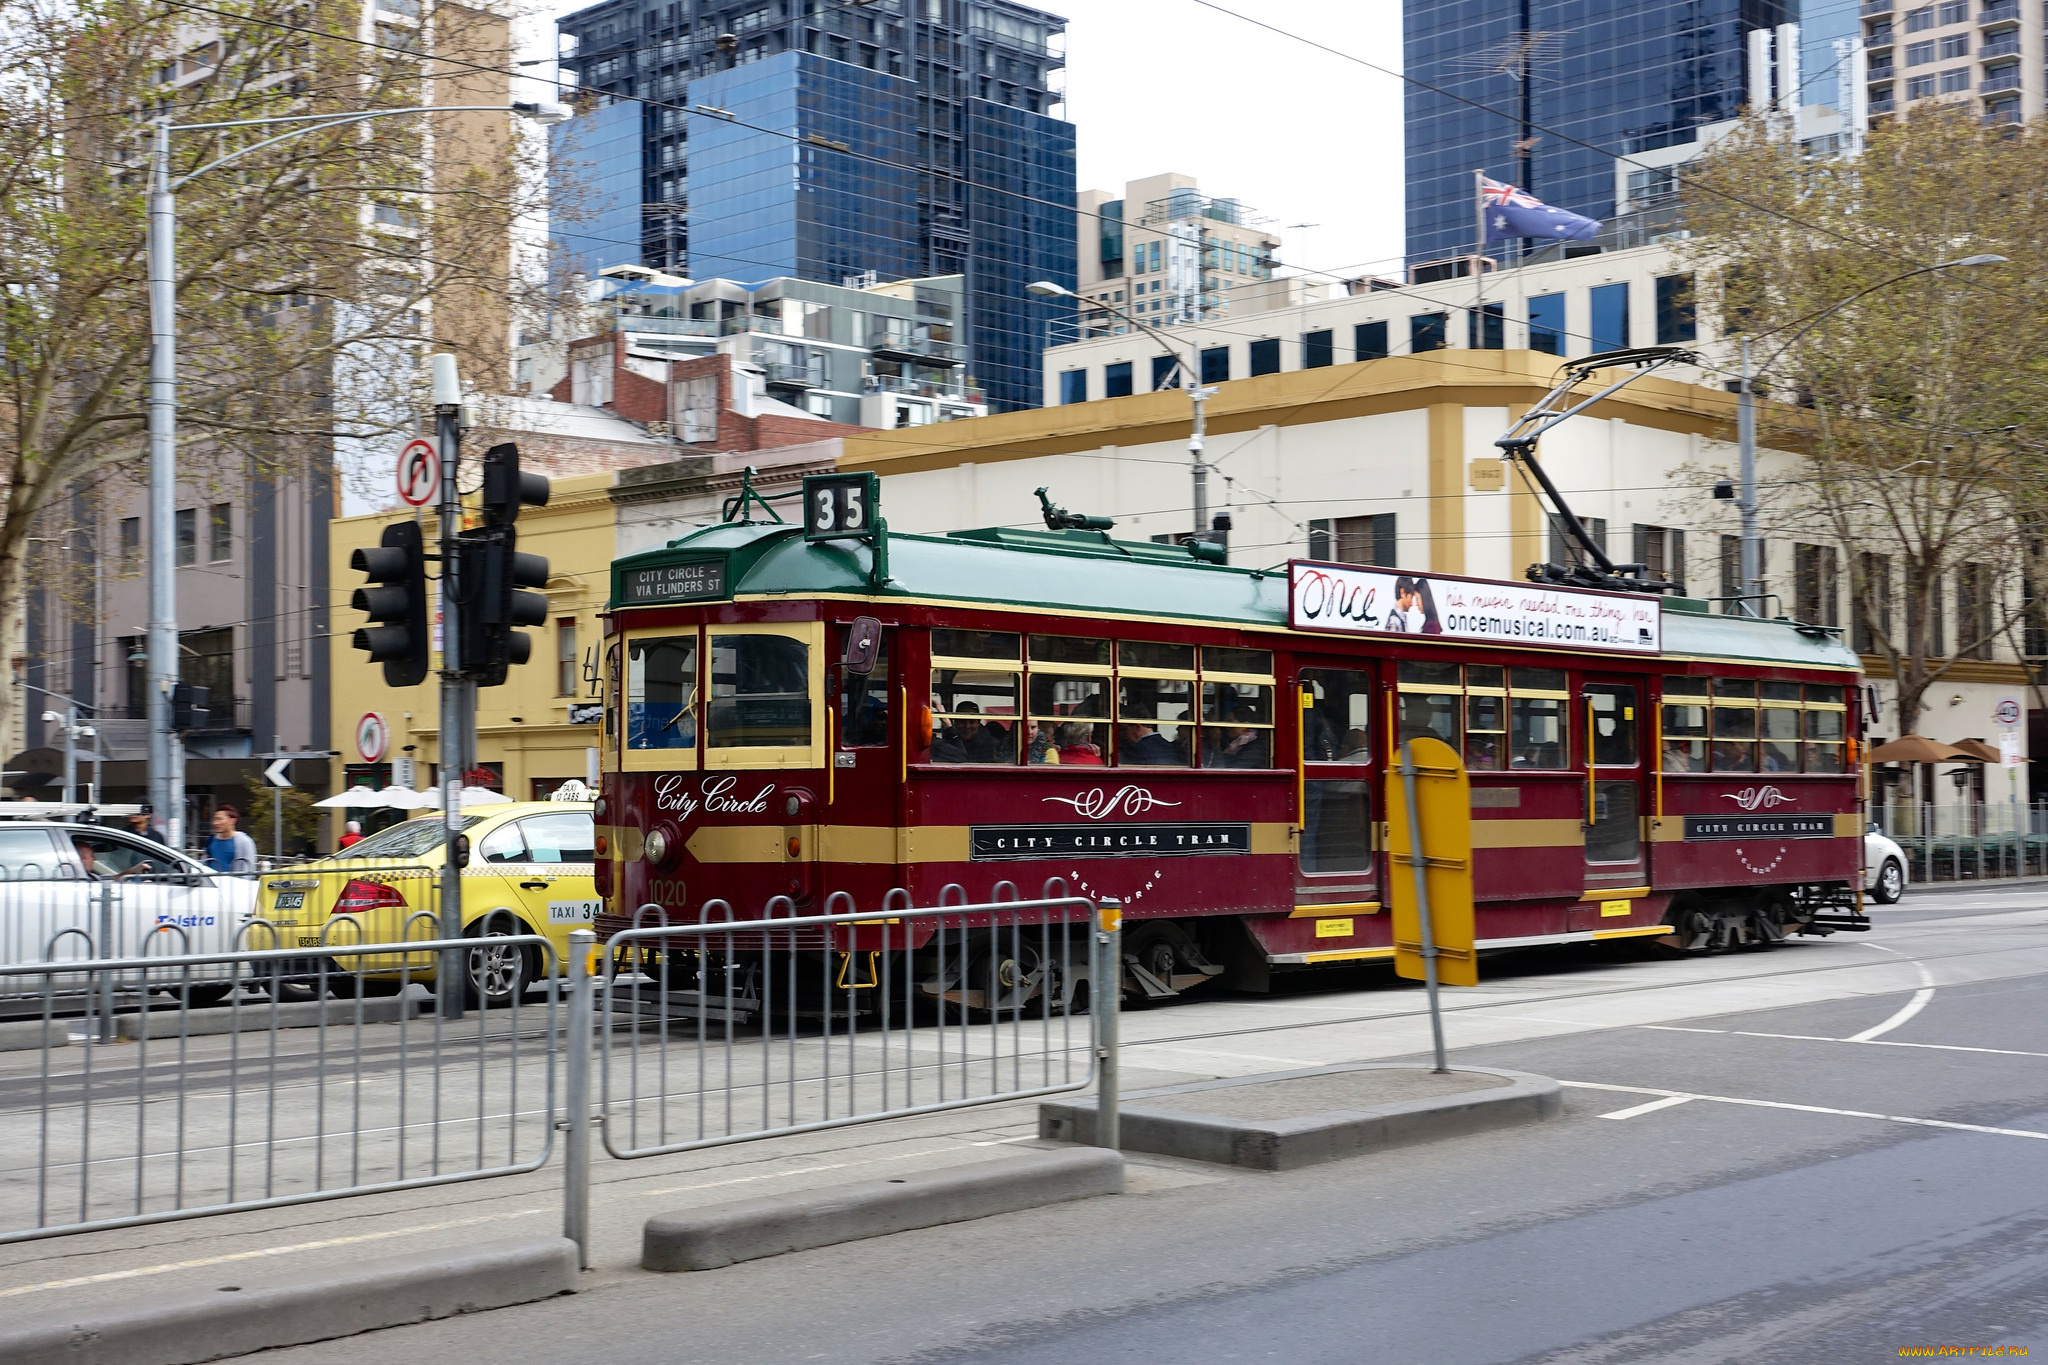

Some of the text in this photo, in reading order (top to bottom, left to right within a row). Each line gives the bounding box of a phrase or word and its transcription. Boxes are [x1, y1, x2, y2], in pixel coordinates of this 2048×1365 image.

[816, 488, 863, 530] 35
[639, 569, 662, 583] CITY
[668, 566, 704, 580] CIRCLE
[636, 579, 721, 597] VIA FLINDERS ST
[1446, 585, 1466, 608] his
[1472, 592, 1514, 609] music
[1519, 592, 1560, 615] needed
[1564, 604, 1585, 618] one
[1448, 614, 1609, 641] oncemusical.com.au
[563, 784, 577, 792] TAXI
[563, 793, 580, 801] CABS
[654, 774, 776, 822] City Circle
[1696, 822, 1824, 833] CITY CIRCLE TRAM
[997, 834, 1230, 849] CITY CIRCLE TRAM
[648, 880, 687, 907] 1020
[1071, 870, 1162, 904] MELURNE
[550, 907, 575, 918] TAXI
